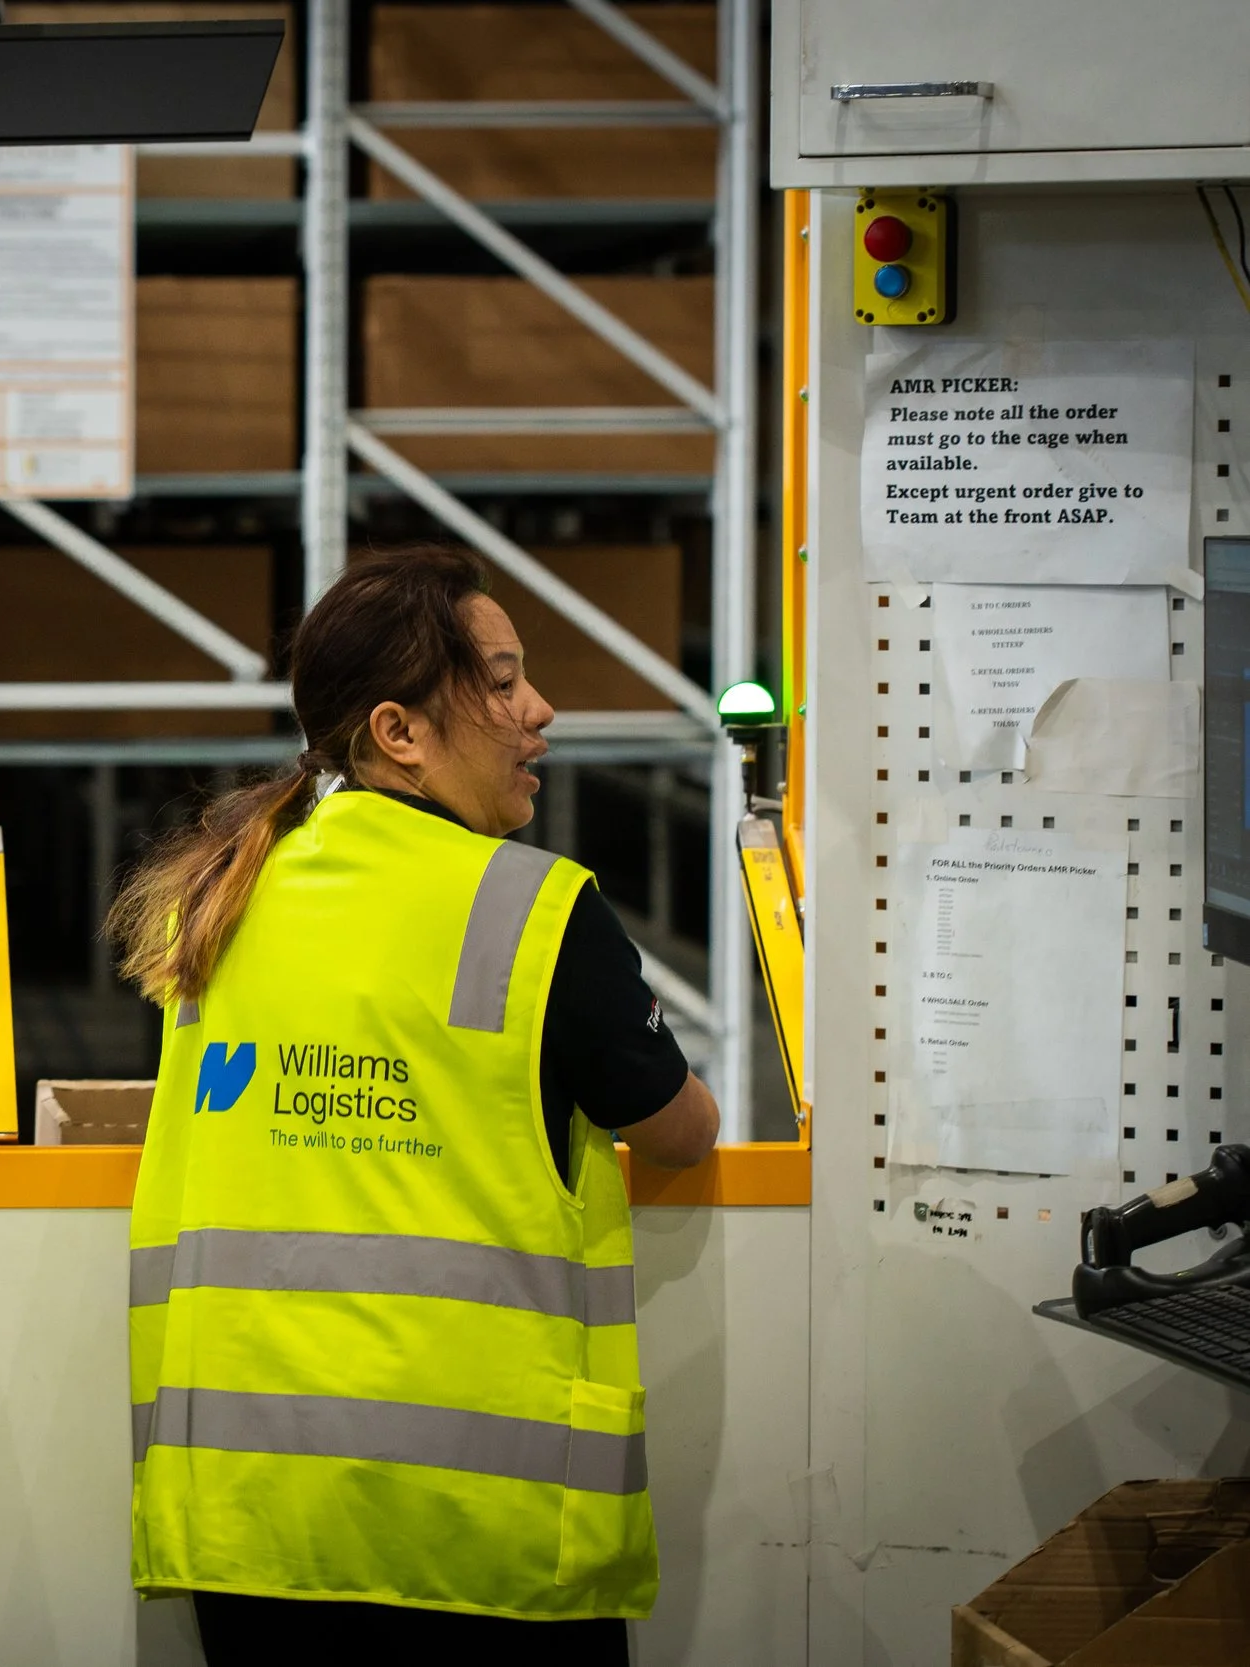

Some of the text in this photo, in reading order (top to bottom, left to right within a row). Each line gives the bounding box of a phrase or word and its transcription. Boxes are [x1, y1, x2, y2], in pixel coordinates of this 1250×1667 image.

[890, 378, 1019, 394] AMR PICKER:
[891, 404, 1118, 422] Please note all the order
[888, 429, 1128, 450] must go to the cage when
[886, 456, 978, 471] available.
[886, 484, 1144, 502] Except urgent order give to
[887, 508, 1114, 524] Team at the front ASAP.
[1024, 626, 1053, 634] ORDERS
[1005, 667, 1035, 675] ORDERS
[932, 859, 949, 868] FOR
[951, 861, 966, 869] ALL
[984, 863, 1015, 872] Priority
[1017, 864, 1046, 873] Orders
[1048, 865, 1068, 874] AMR
[1069, 867, 1097, 875] Picker
[933, 875, 957, 883] Online
[968, 999, 989, 1007] Order
[927, 1038, 948, 1046] Retail
[948, 1039, 969, 1047] Order
[278, 1043, 409, 1083] Williams
[273, 1082, 418, 1125] Logistics
[270, 1128, 443, 1158] The will to go further
